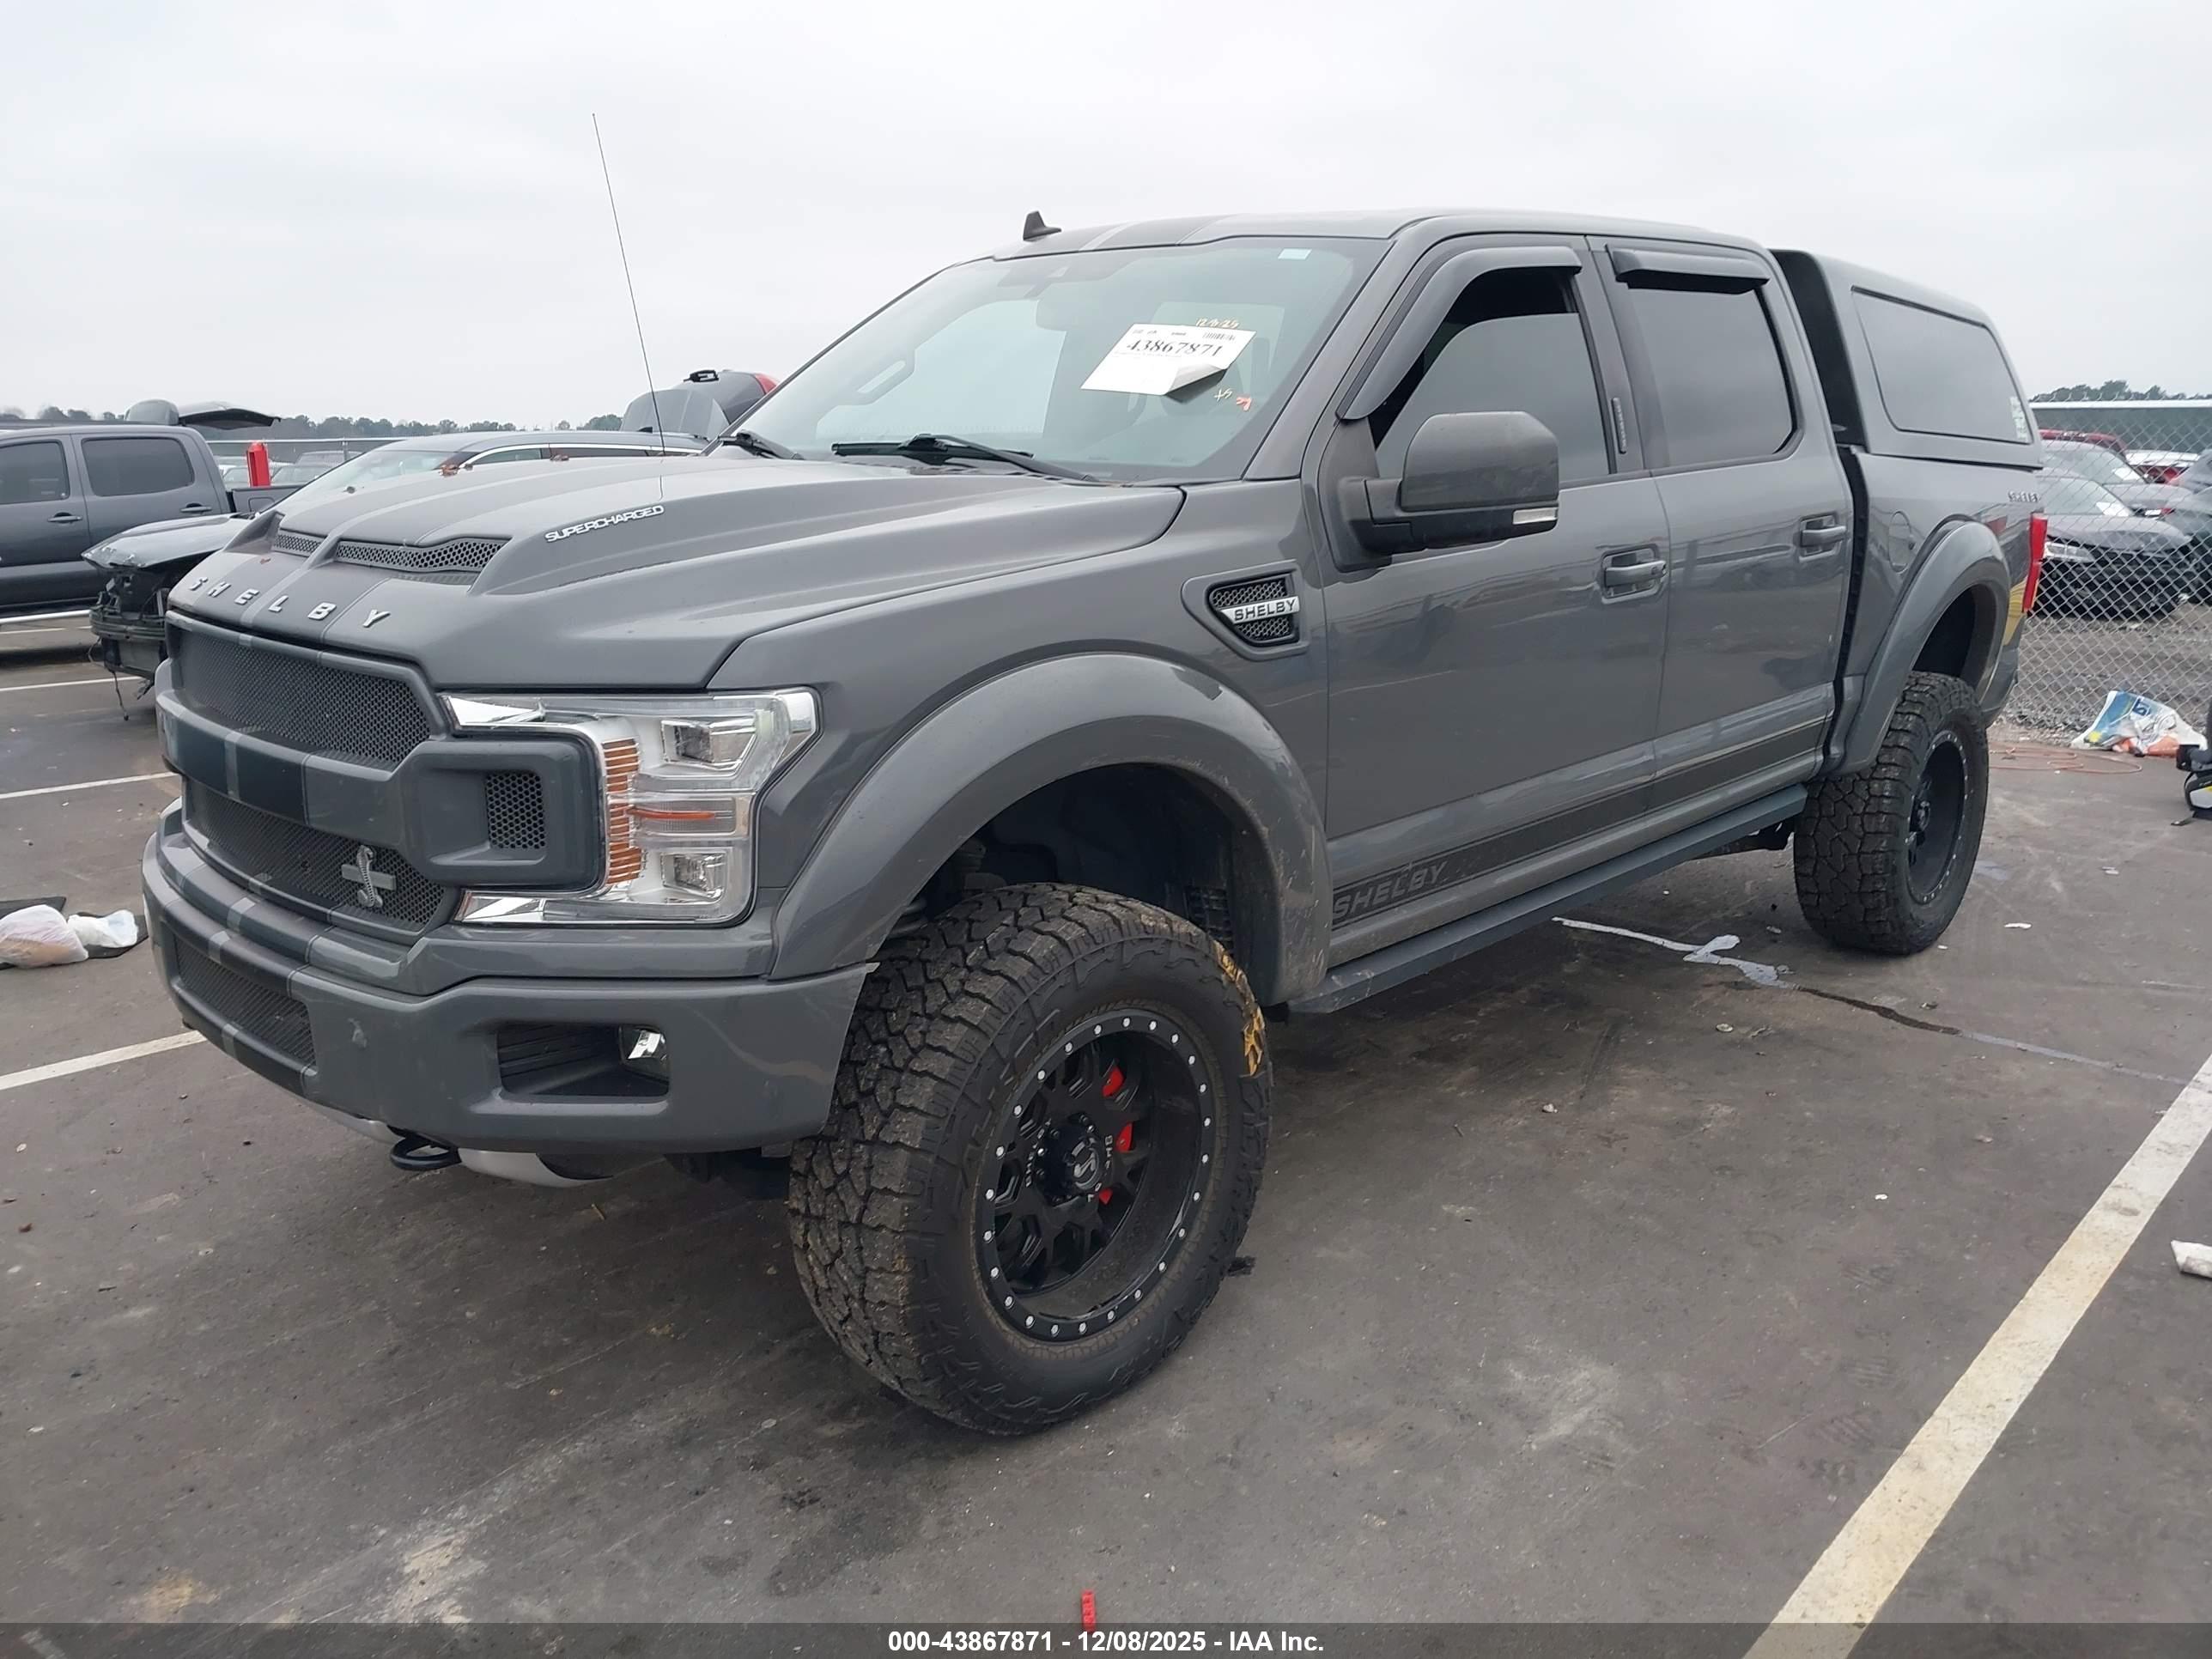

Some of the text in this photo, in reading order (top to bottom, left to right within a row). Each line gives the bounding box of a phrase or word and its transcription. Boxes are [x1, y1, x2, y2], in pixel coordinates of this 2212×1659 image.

[1127, 339, 1223, 356] 43867871
[545, 505, 665, 542] SUPERCHARGED
[189, 576, 391, 628] SHELBY
[1234, 599, 1296, 621] SHELBY
[1334, 861, 1449, 919] SHELBY
